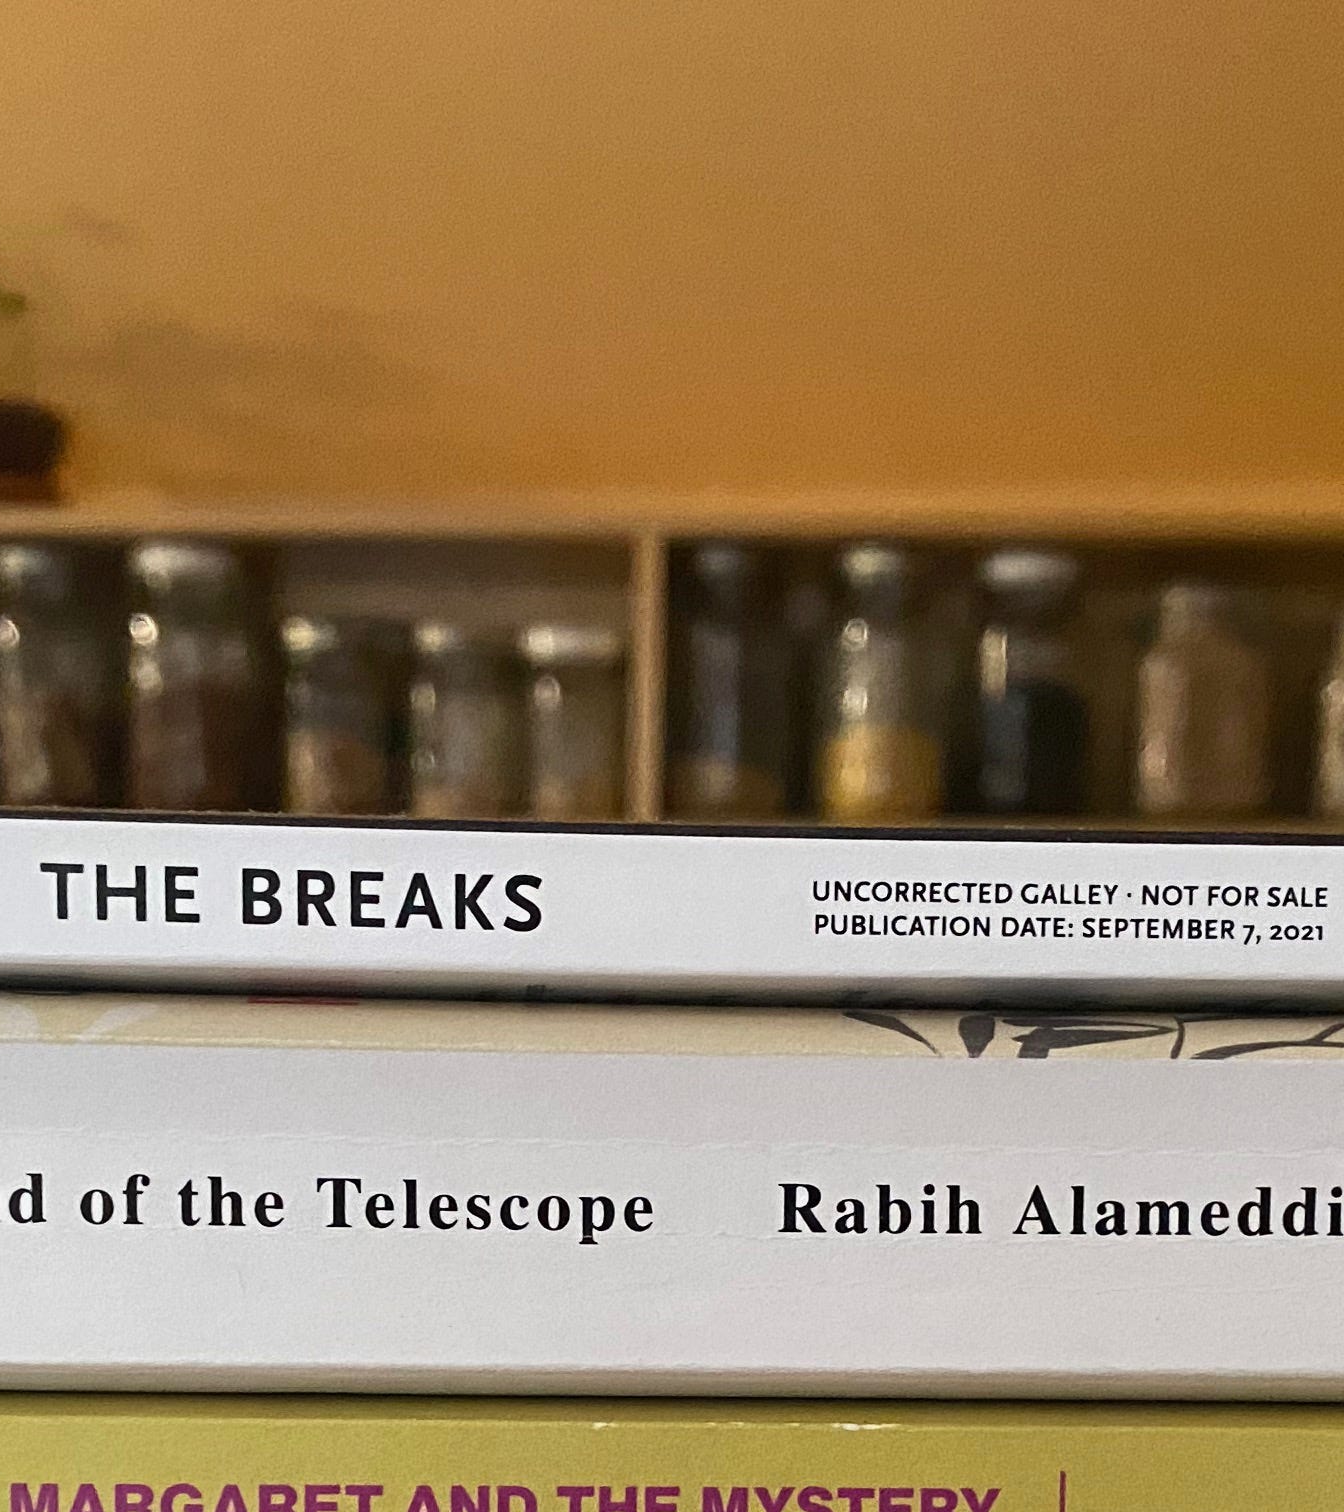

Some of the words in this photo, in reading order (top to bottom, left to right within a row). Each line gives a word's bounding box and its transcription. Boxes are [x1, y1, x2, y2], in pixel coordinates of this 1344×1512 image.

[39, 862, 201, 924] THE
[241, 867, 543, 933] BREAKS
[812, 880, 1013, 904] UNCORRECTED
[1020, 883, 1119, 905] GALLEY
[1141, 884, 1200, 907] NOT
[1207, 885, 1259, 907] FOR
[1266, 886, 1329, 908] SALE
[814, 914, 991, 938] PUBLICATION
[1001, 916, 1074, 938] DATE:
[1082, 917, 1235, 940] SEPTEMBER
[1242, 924, 1262, 946] 7,
[1269, 924, 1323, 941] 2021
[79, 1173, 151, 1226] of
[177, 1175, 285, 1228] the
[316, 1177, 654, 1245] Telescope
[777, 1183, 983, 1235] Rabih
